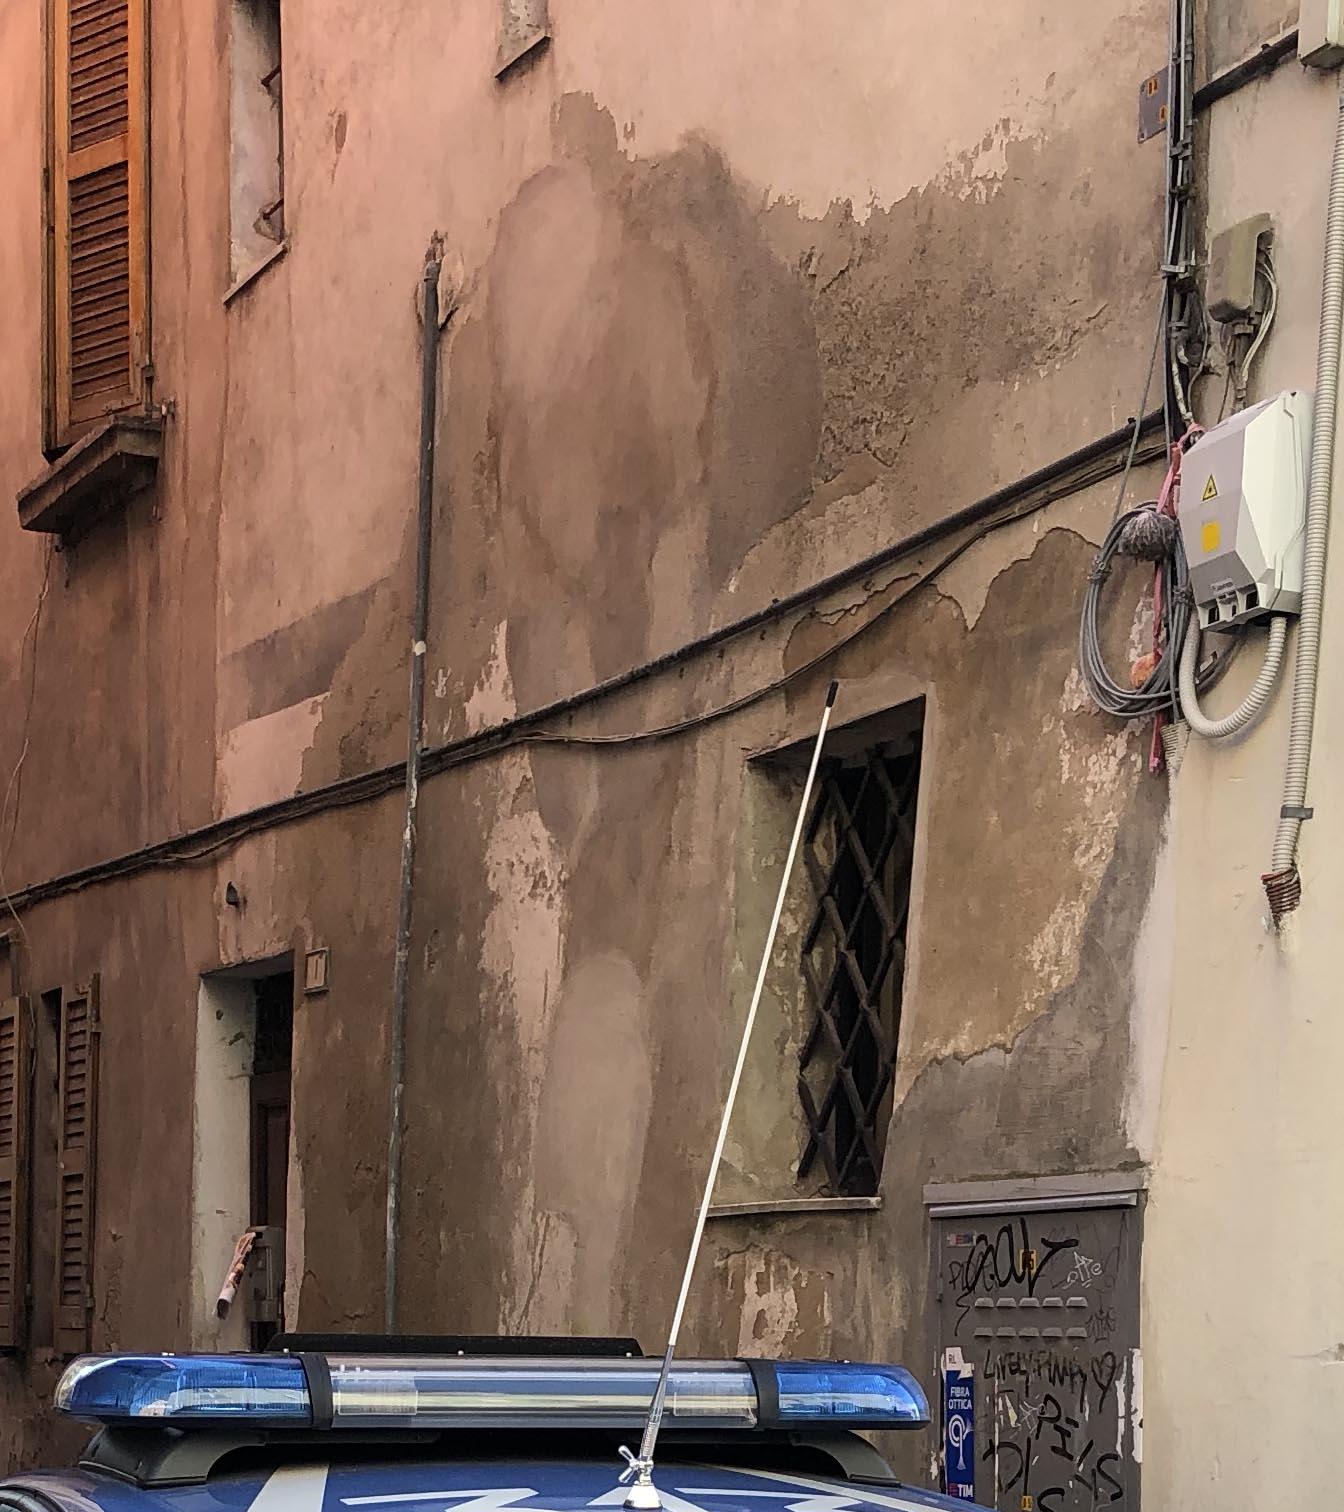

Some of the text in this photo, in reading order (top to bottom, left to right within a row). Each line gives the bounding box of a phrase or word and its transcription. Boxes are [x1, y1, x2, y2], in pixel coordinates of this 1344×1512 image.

[950, 1386, 970, 1398] FIBRA
[948, 1399, 973, 1411] OTTICA
[958, 1484, 974, 1498] TIM
